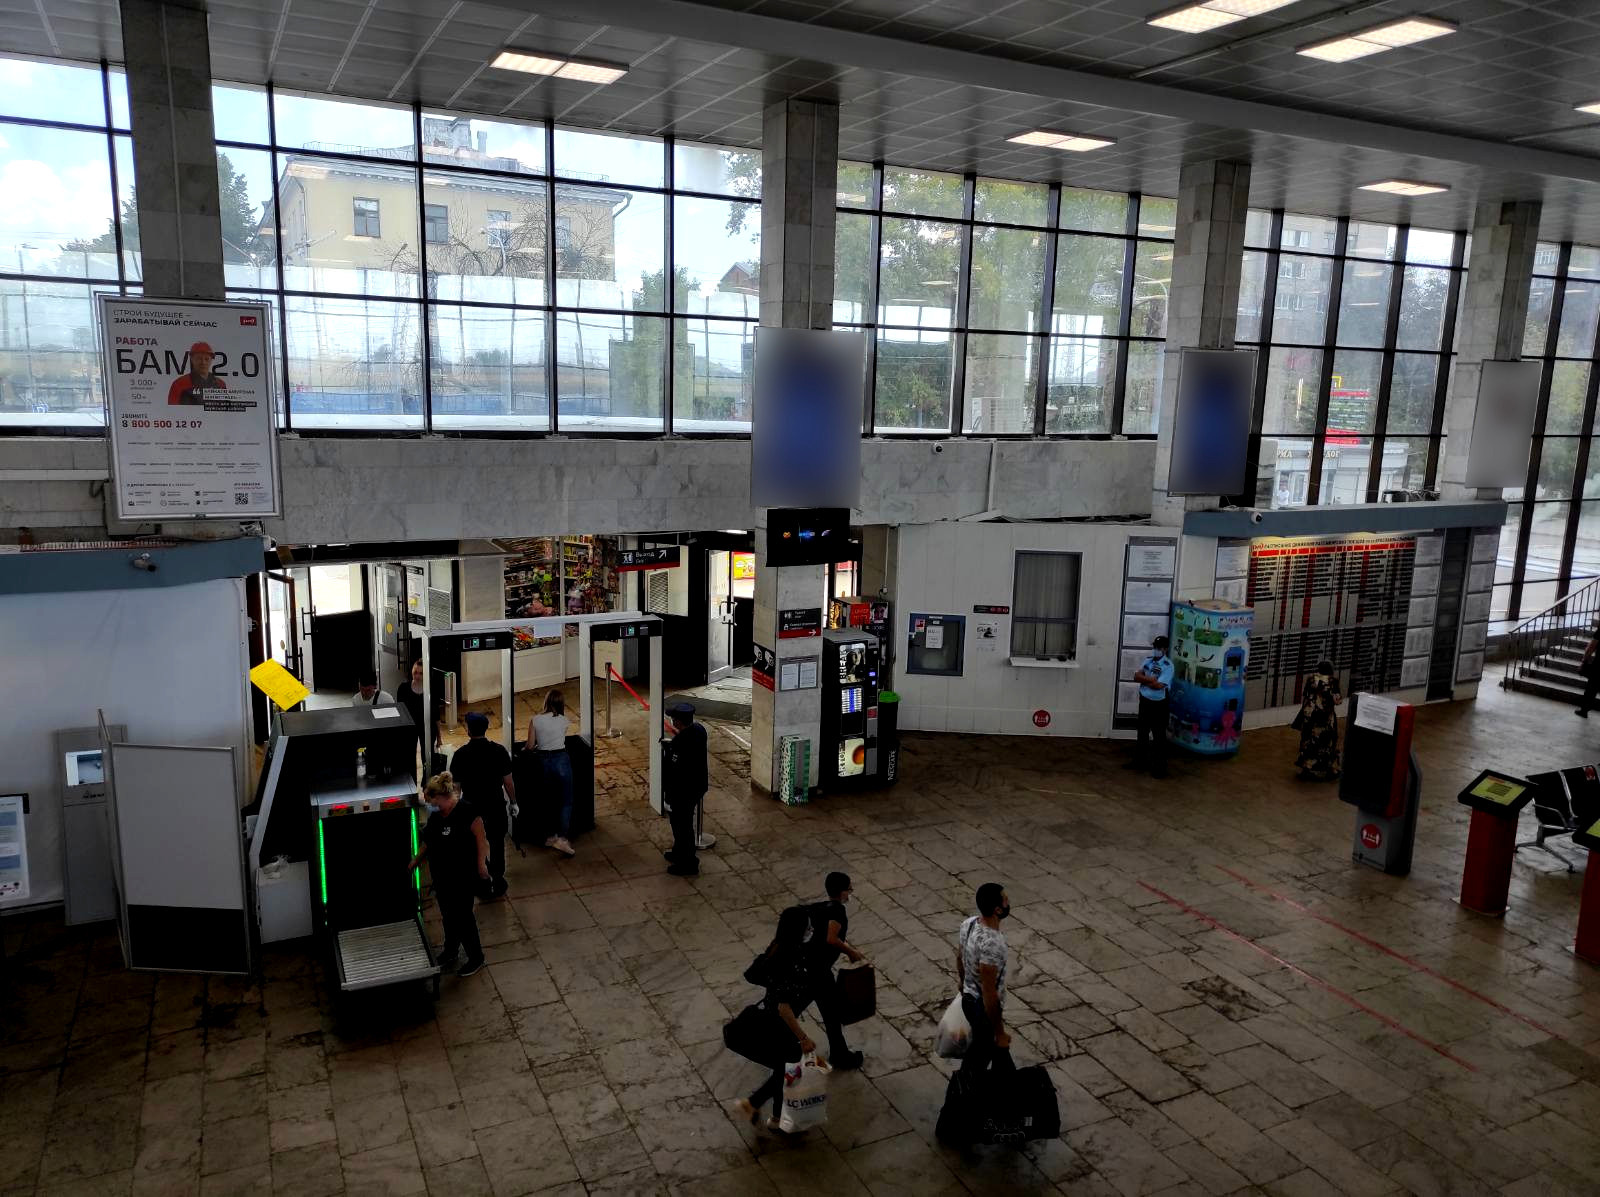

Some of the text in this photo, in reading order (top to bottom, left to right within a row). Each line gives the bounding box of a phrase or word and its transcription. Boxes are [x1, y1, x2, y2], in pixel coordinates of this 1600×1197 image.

[113, 317, 218, 328] ЗАРАБАТЫВАЙ СЕЙЧАС
[115, 336, 158, 346] РАБОТА
[116, 348, 259, 378] БАМ 2.0
[121, 420, 203, 429] 8 800 500 12 07
